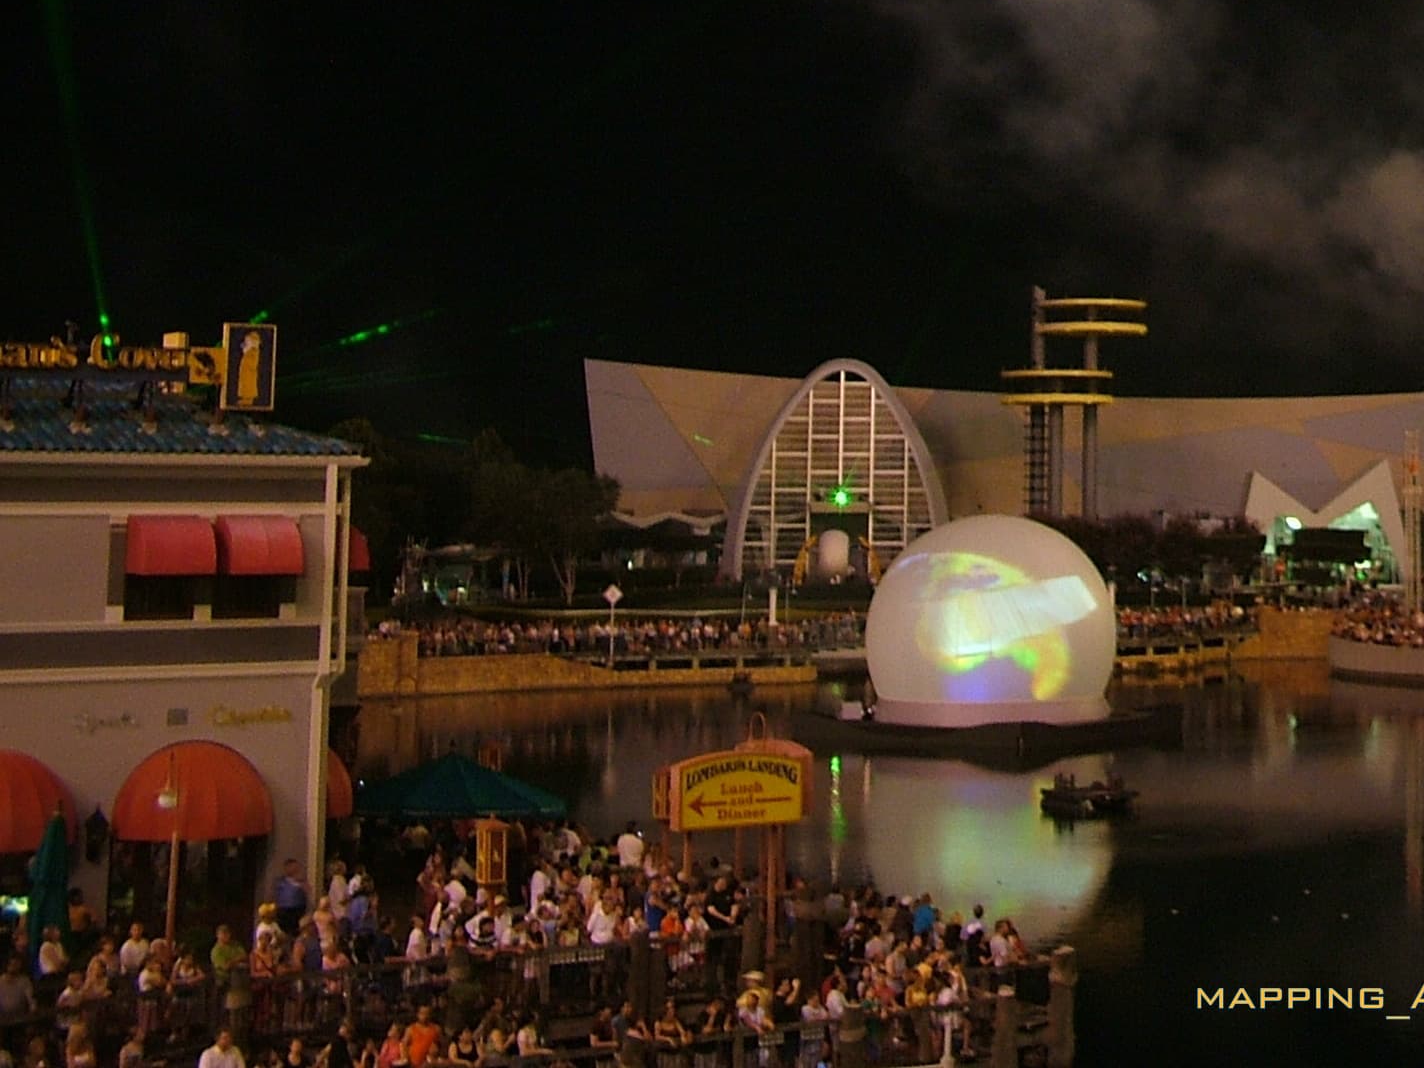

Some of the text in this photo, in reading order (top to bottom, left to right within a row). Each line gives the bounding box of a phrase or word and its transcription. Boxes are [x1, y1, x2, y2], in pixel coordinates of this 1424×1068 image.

[748, 760, 798, 785] LANDING
[720, 781, 764, 796] Lunch
[730, 794, 753, 806] and
[717, 808, 767, 821] Dinner
